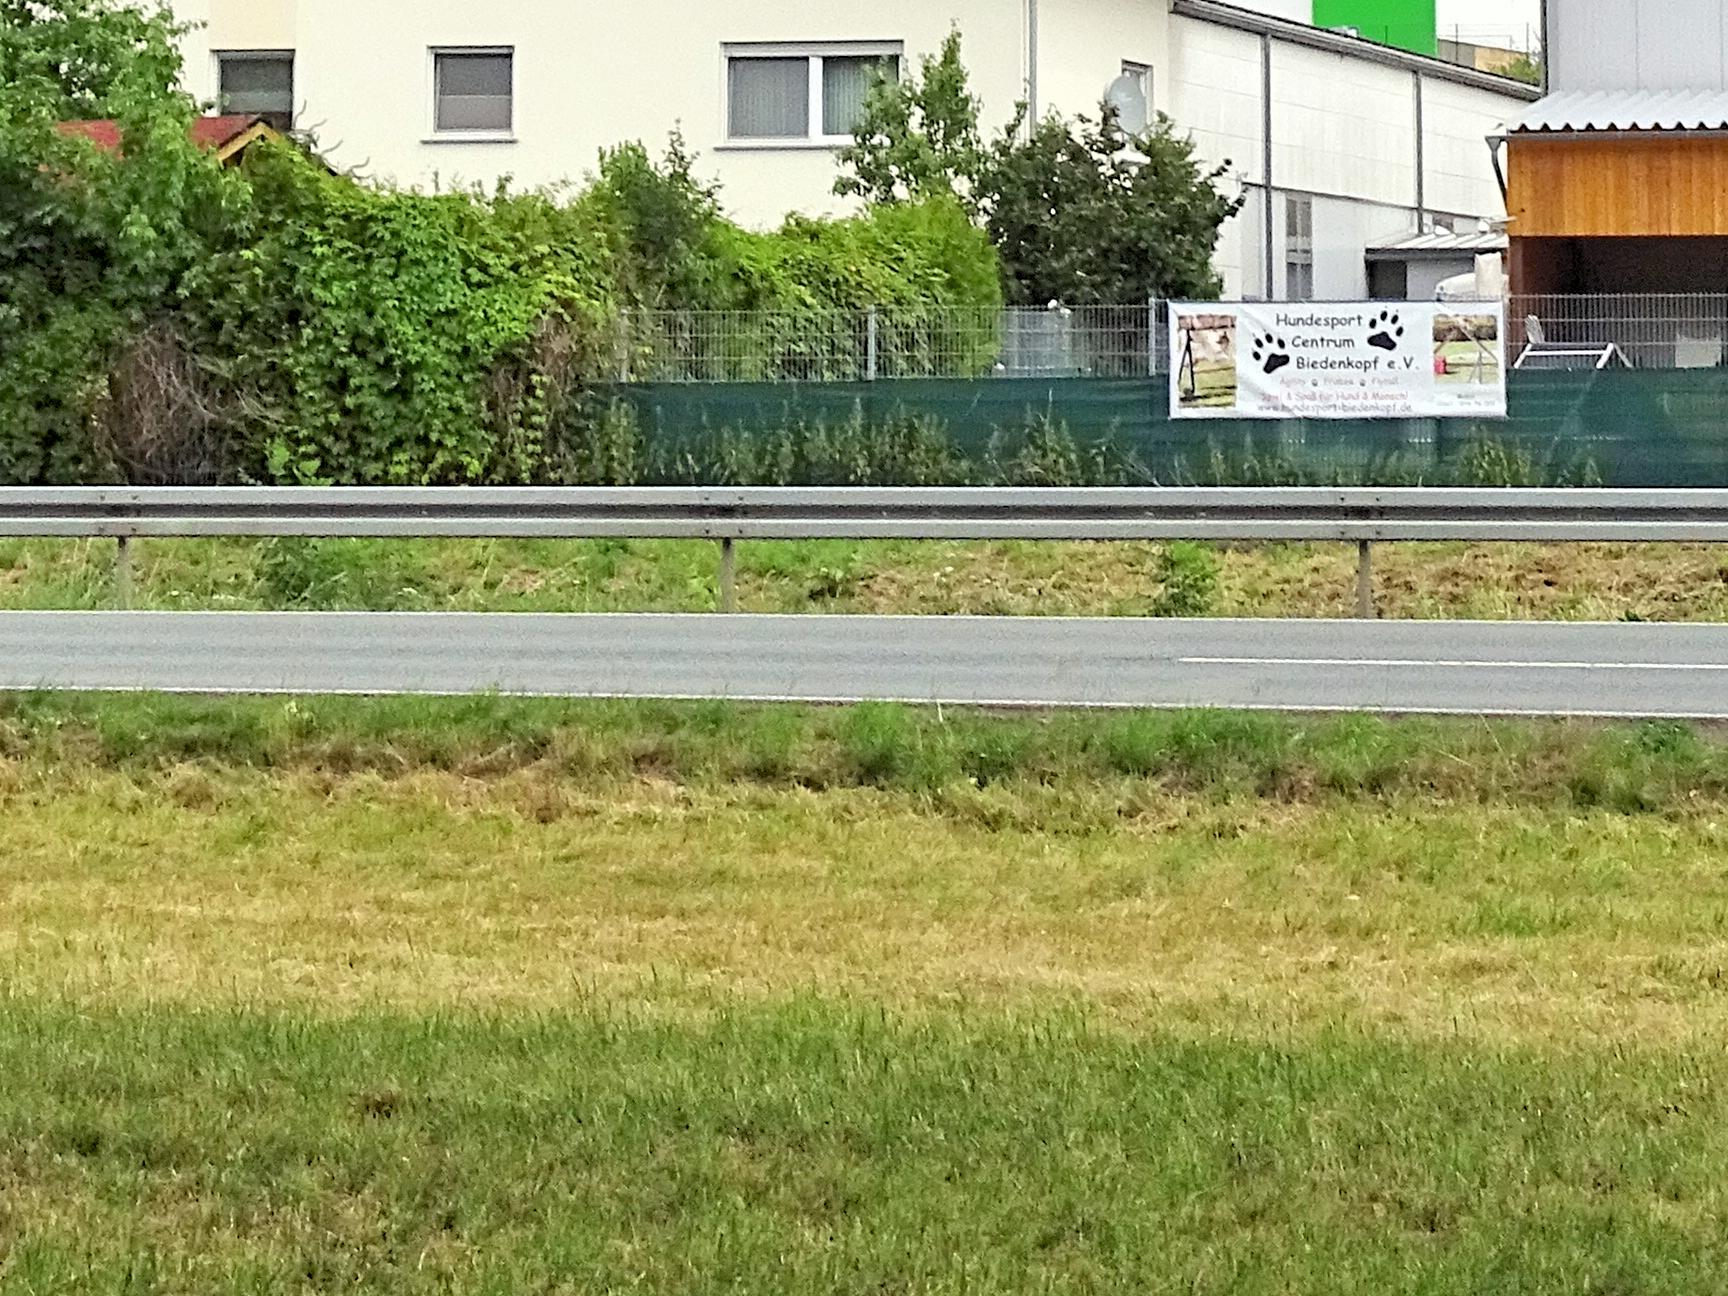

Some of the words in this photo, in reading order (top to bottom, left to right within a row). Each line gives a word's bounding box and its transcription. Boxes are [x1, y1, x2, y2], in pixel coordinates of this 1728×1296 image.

[1276, 313, 1363, 330] Hundesport
[1291, 335, 1355, 348] Centrum
[1296, 355, 1379, 372] Biedenkopf
[1387, 355, 1420, 370] e.V.
